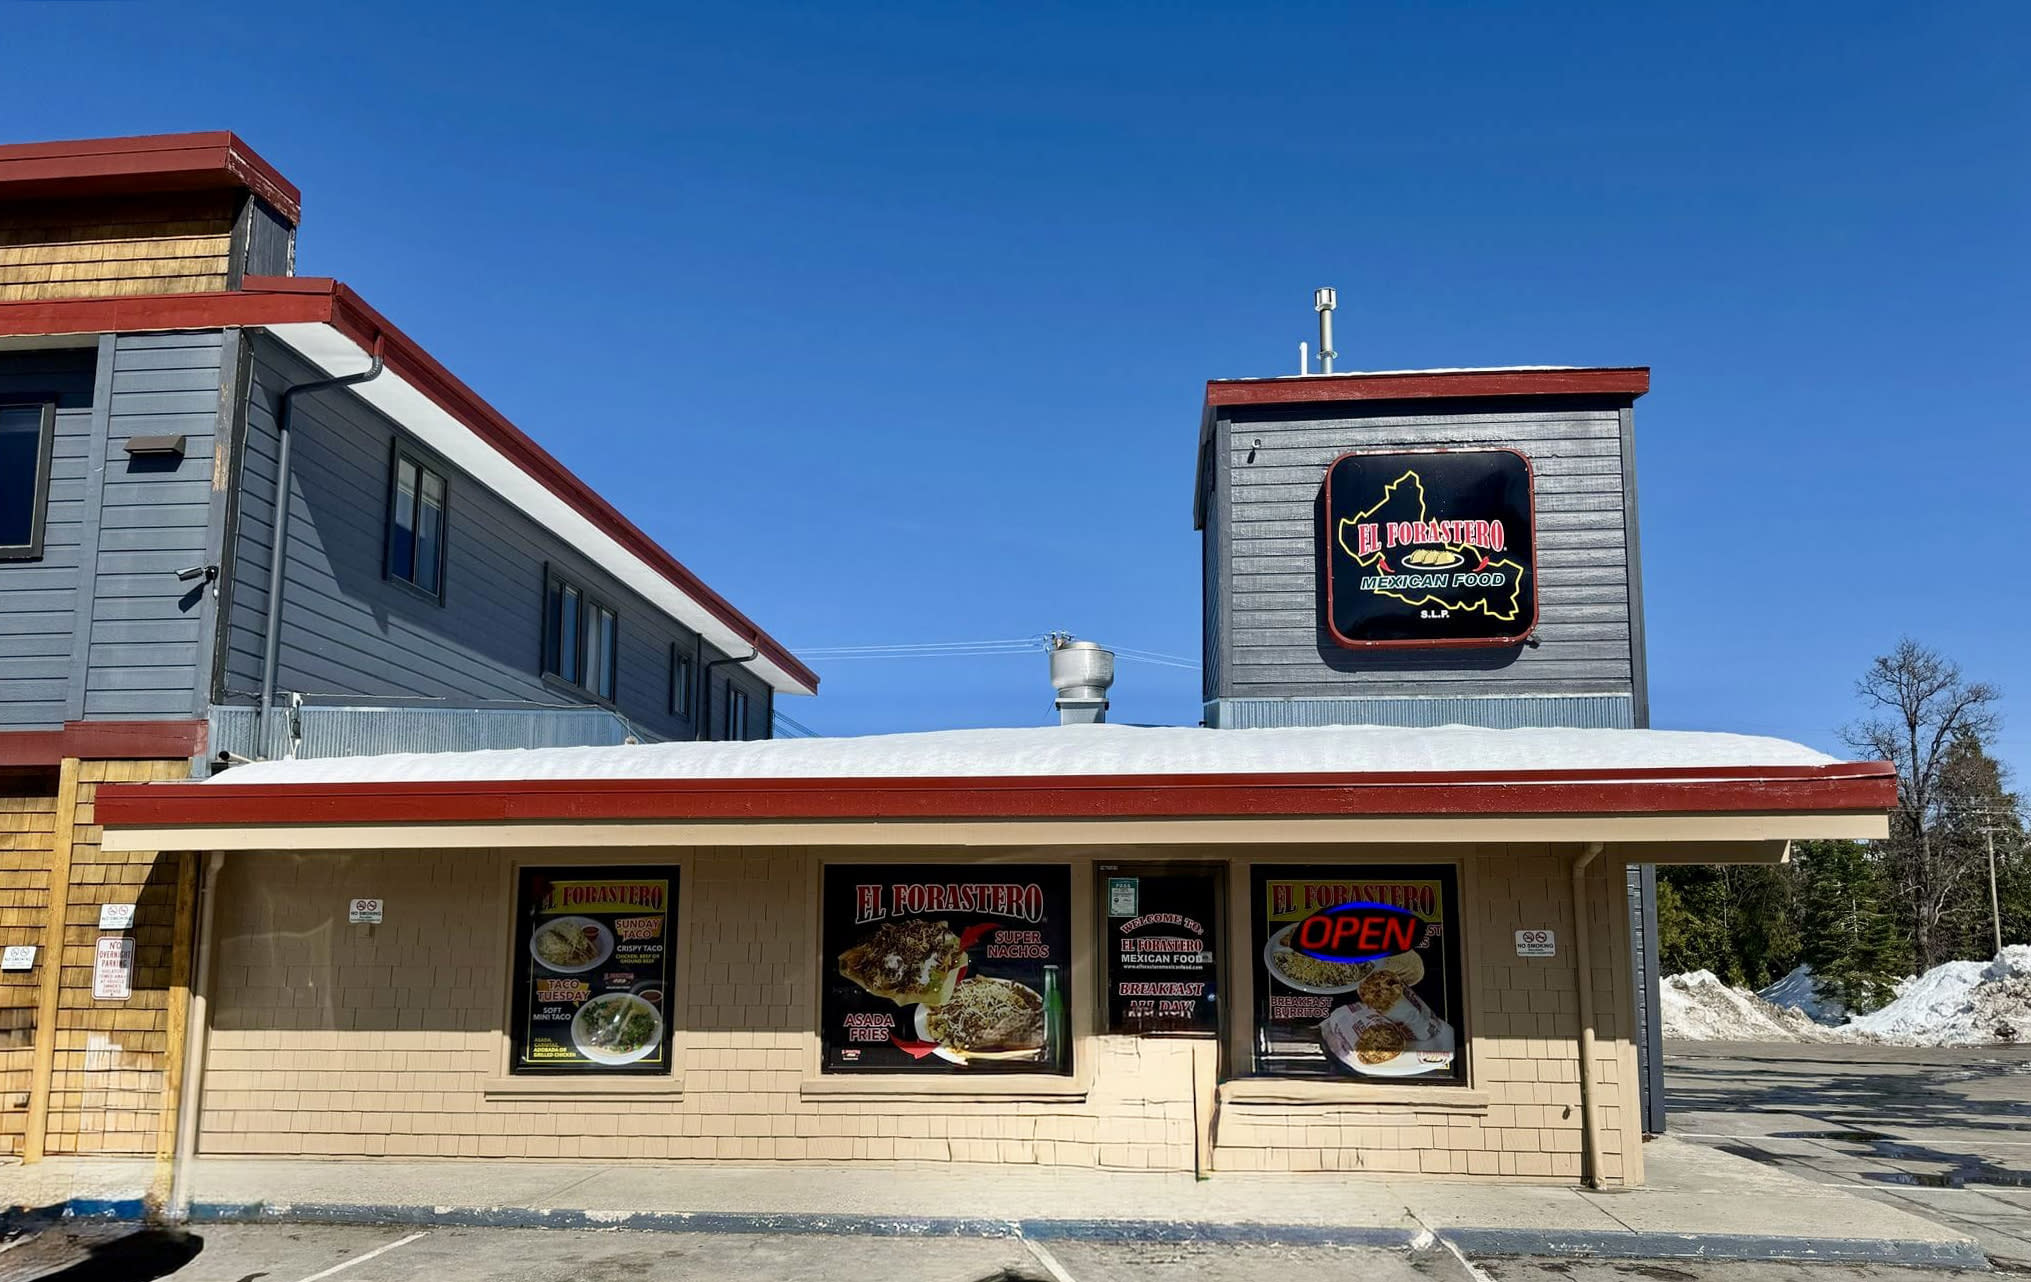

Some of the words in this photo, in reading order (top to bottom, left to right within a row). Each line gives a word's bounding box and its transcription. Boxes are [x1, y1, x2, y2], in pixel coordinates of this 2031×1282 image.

[1358, 523, 1382, 556] EL
[1386, 519, 1504, 552] FORASTERO
[1360, 573, 1448, 590] MEXICAN
[1452, 572, 1506, 587] FOOD
[1420, 610, 1450, 618] S.L.P.
[562, 885, 663, 910] FORASTERO
[856, 885, 886, 924] EL
[892, 884, 1043, 923] FORASTERO
[1272, 885, 1297, 916] EL
[1304, 885, 1436, 917] FORASTERO
[616, 919, 659, 929] SUNDAY
[1120, 913, 1182, 934] WELCOME
[623, 929, 652, 939] TACO
[995, 931, 1041, 944] SUPER
[1300, 914, 1417, 951] OPEN
[110, 942, 122, 950] NO
[987, 945, 1049, 958] NACHOS
[1120, 939, 1135, 952] EL
[1137, 937, 1203, 953] FORASTERO
[100, 951, 131, 959] OVERNIGHT
[1121, 954, 1170, 963] MEXICAN
[1173, 954, 1203, 963] FOOD
[102, 960, 127, 968] PARKING
[547, 979, 580, 990] TACO
[1119, 982, 1205, 996] BREAKFAST
[537, 990, 591, 1001] TUESDAY
[1271, 996, 1333, 1008] BREAKFAST
[1273, 1007, 1329, 1018] BURRITOS
[843, 1013, 895, 1027] ASADA
[849, 1028, 889, 1042] FRIES
